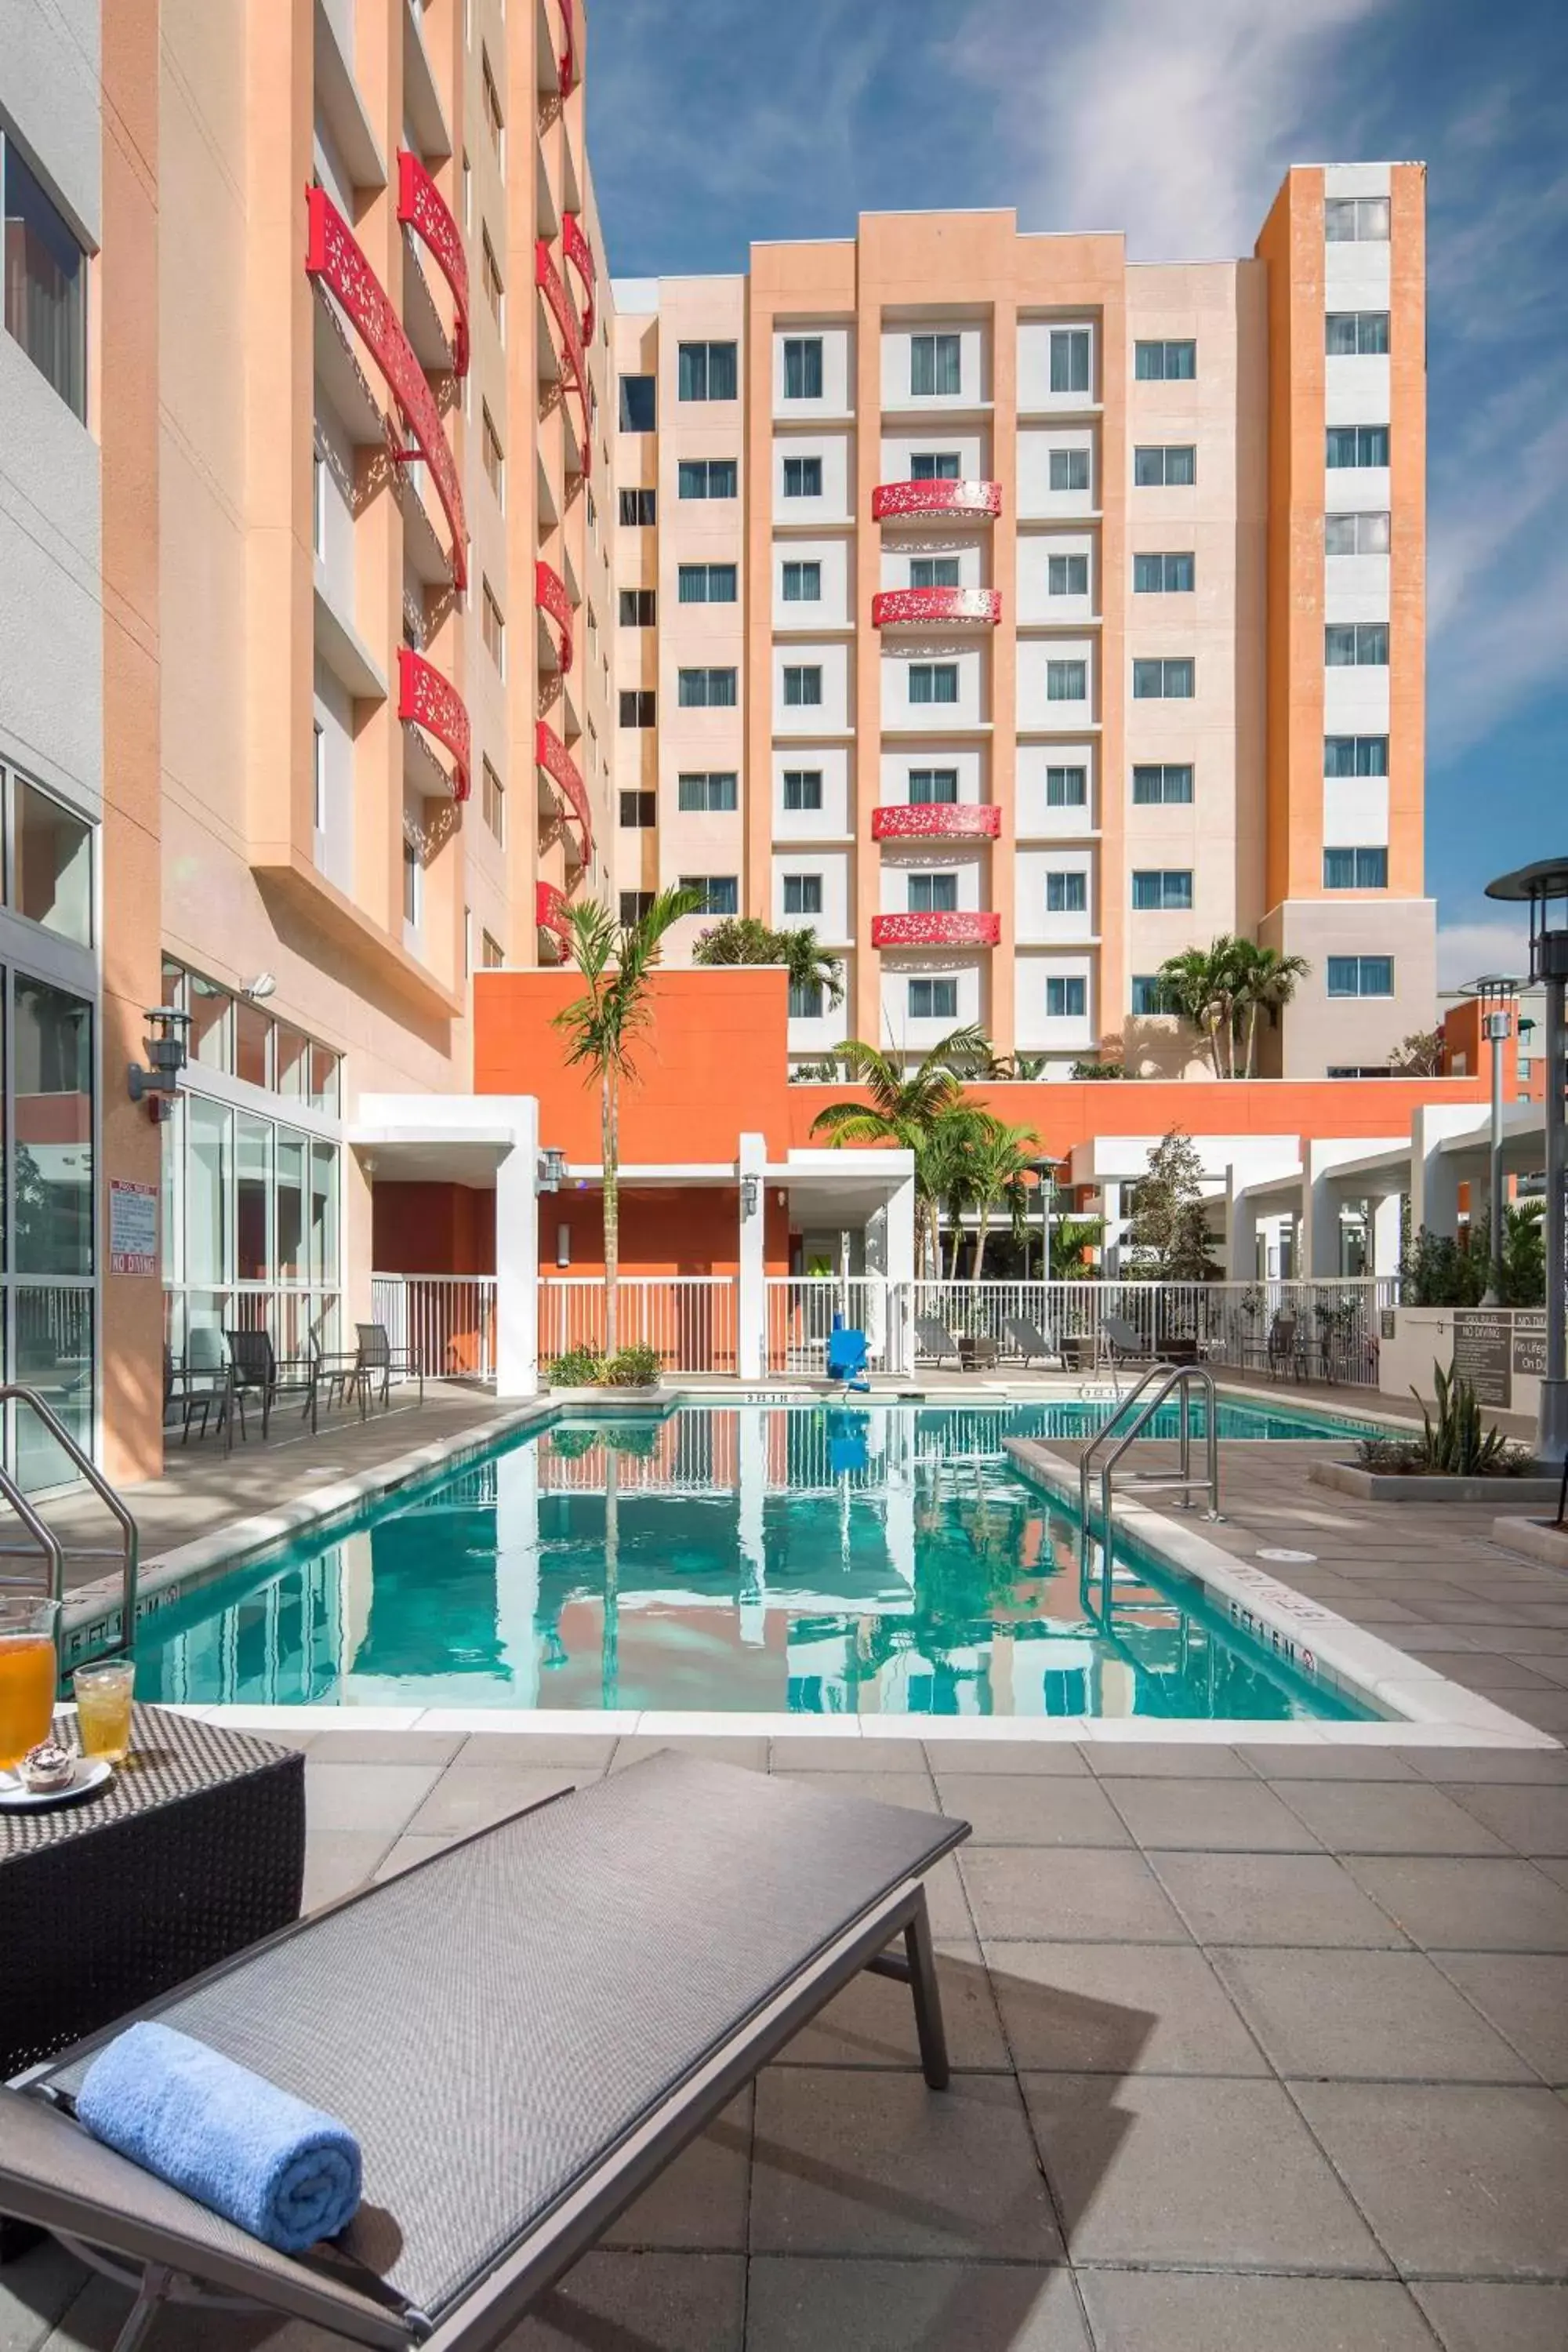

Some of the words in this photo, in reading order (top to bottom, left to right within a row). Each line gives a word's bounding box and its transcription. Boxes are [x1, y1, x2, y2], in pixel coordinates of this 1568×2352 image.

[112, 1254, 125, 1271] NO
[129, 1255, 155, 1273] DIVING
[1463, 1327, 1473, 1337] NO
[1475, 1327, 1500, 1338] DIVING
[1514, 1340, 1526, 1352] No
[1527, 1341, 1547, 1357] Lifeg
[1522, 1358, 1534, 1370] On
